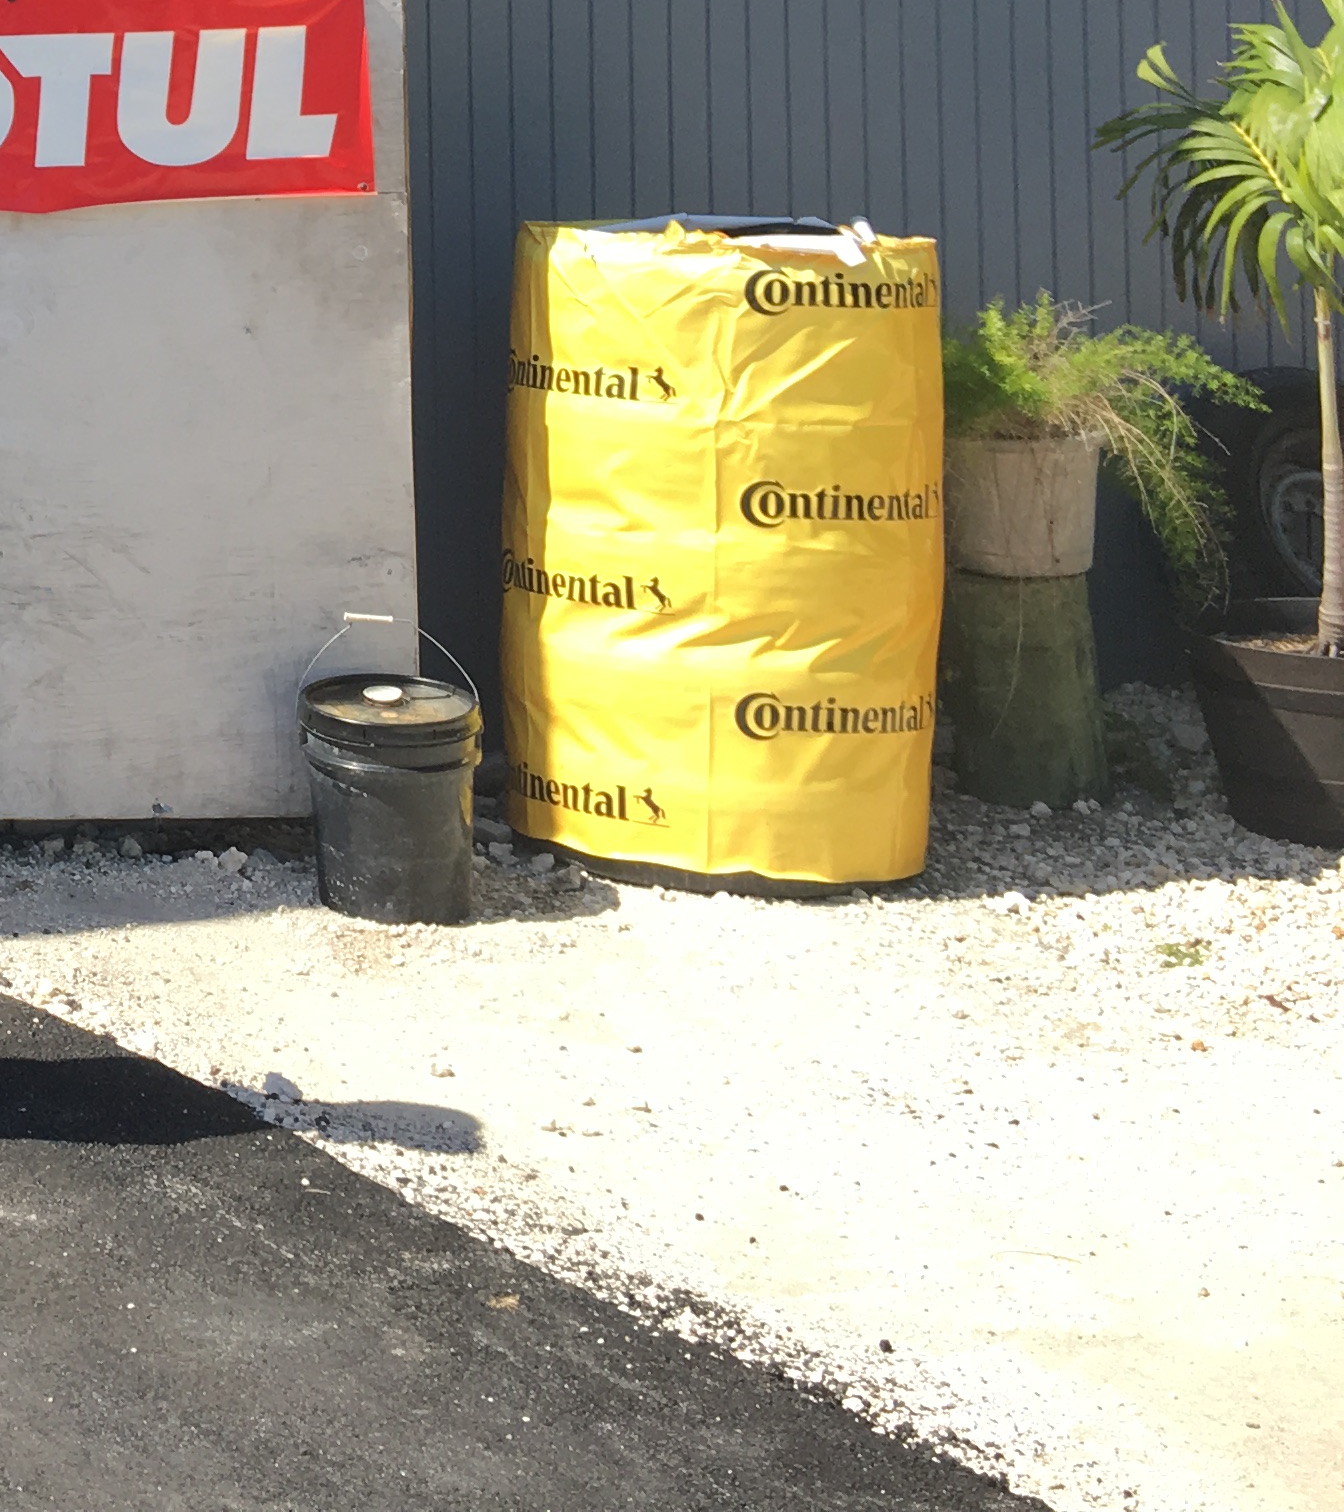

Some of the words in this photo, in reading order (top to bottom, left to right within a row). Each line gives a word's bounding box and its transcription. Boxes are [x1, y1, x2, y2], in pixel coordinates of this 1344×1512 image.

[745, 269, 930, 316] Continental
[740, 480, 930, 529] Continental
[735, 691, 925, 741] Continental
